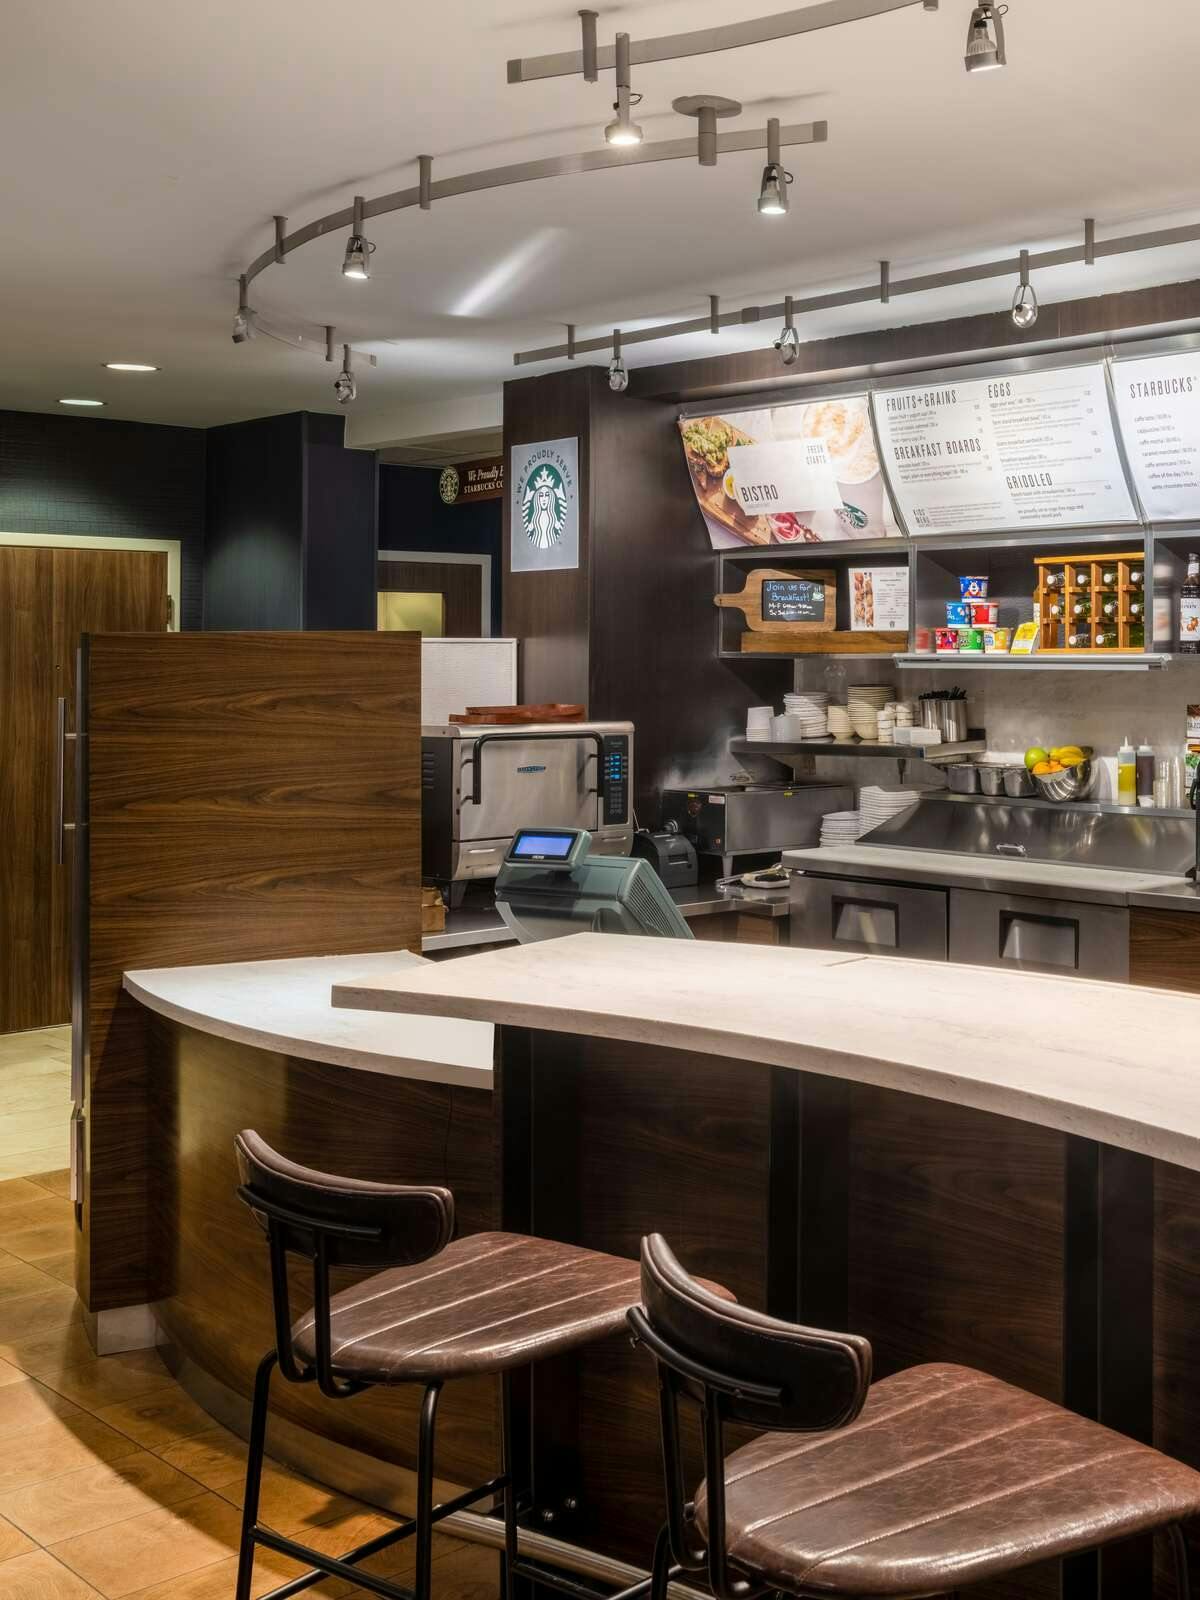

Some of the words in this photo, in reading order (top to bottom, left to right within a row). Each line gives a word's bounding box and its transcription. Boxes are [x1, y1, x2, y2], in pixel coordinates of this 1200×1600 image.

[988, 382, 1011, 399] EGGS
[894, 442, 942, 461] BREAKFAST
[946, 438, 982, 455] BOARDS
[477, 465, 499, 481] Proudly
[523, 449, 556, 473] PROUDLY
[556, 454, 573, 488] SERVE
[464, 481, 496, 494] STARBUCKS
[1006, 472, 1053, 490] GRIDDLED
[740, 484, 779, 503] BISTRO
[766, 581, 785, 591] Join
